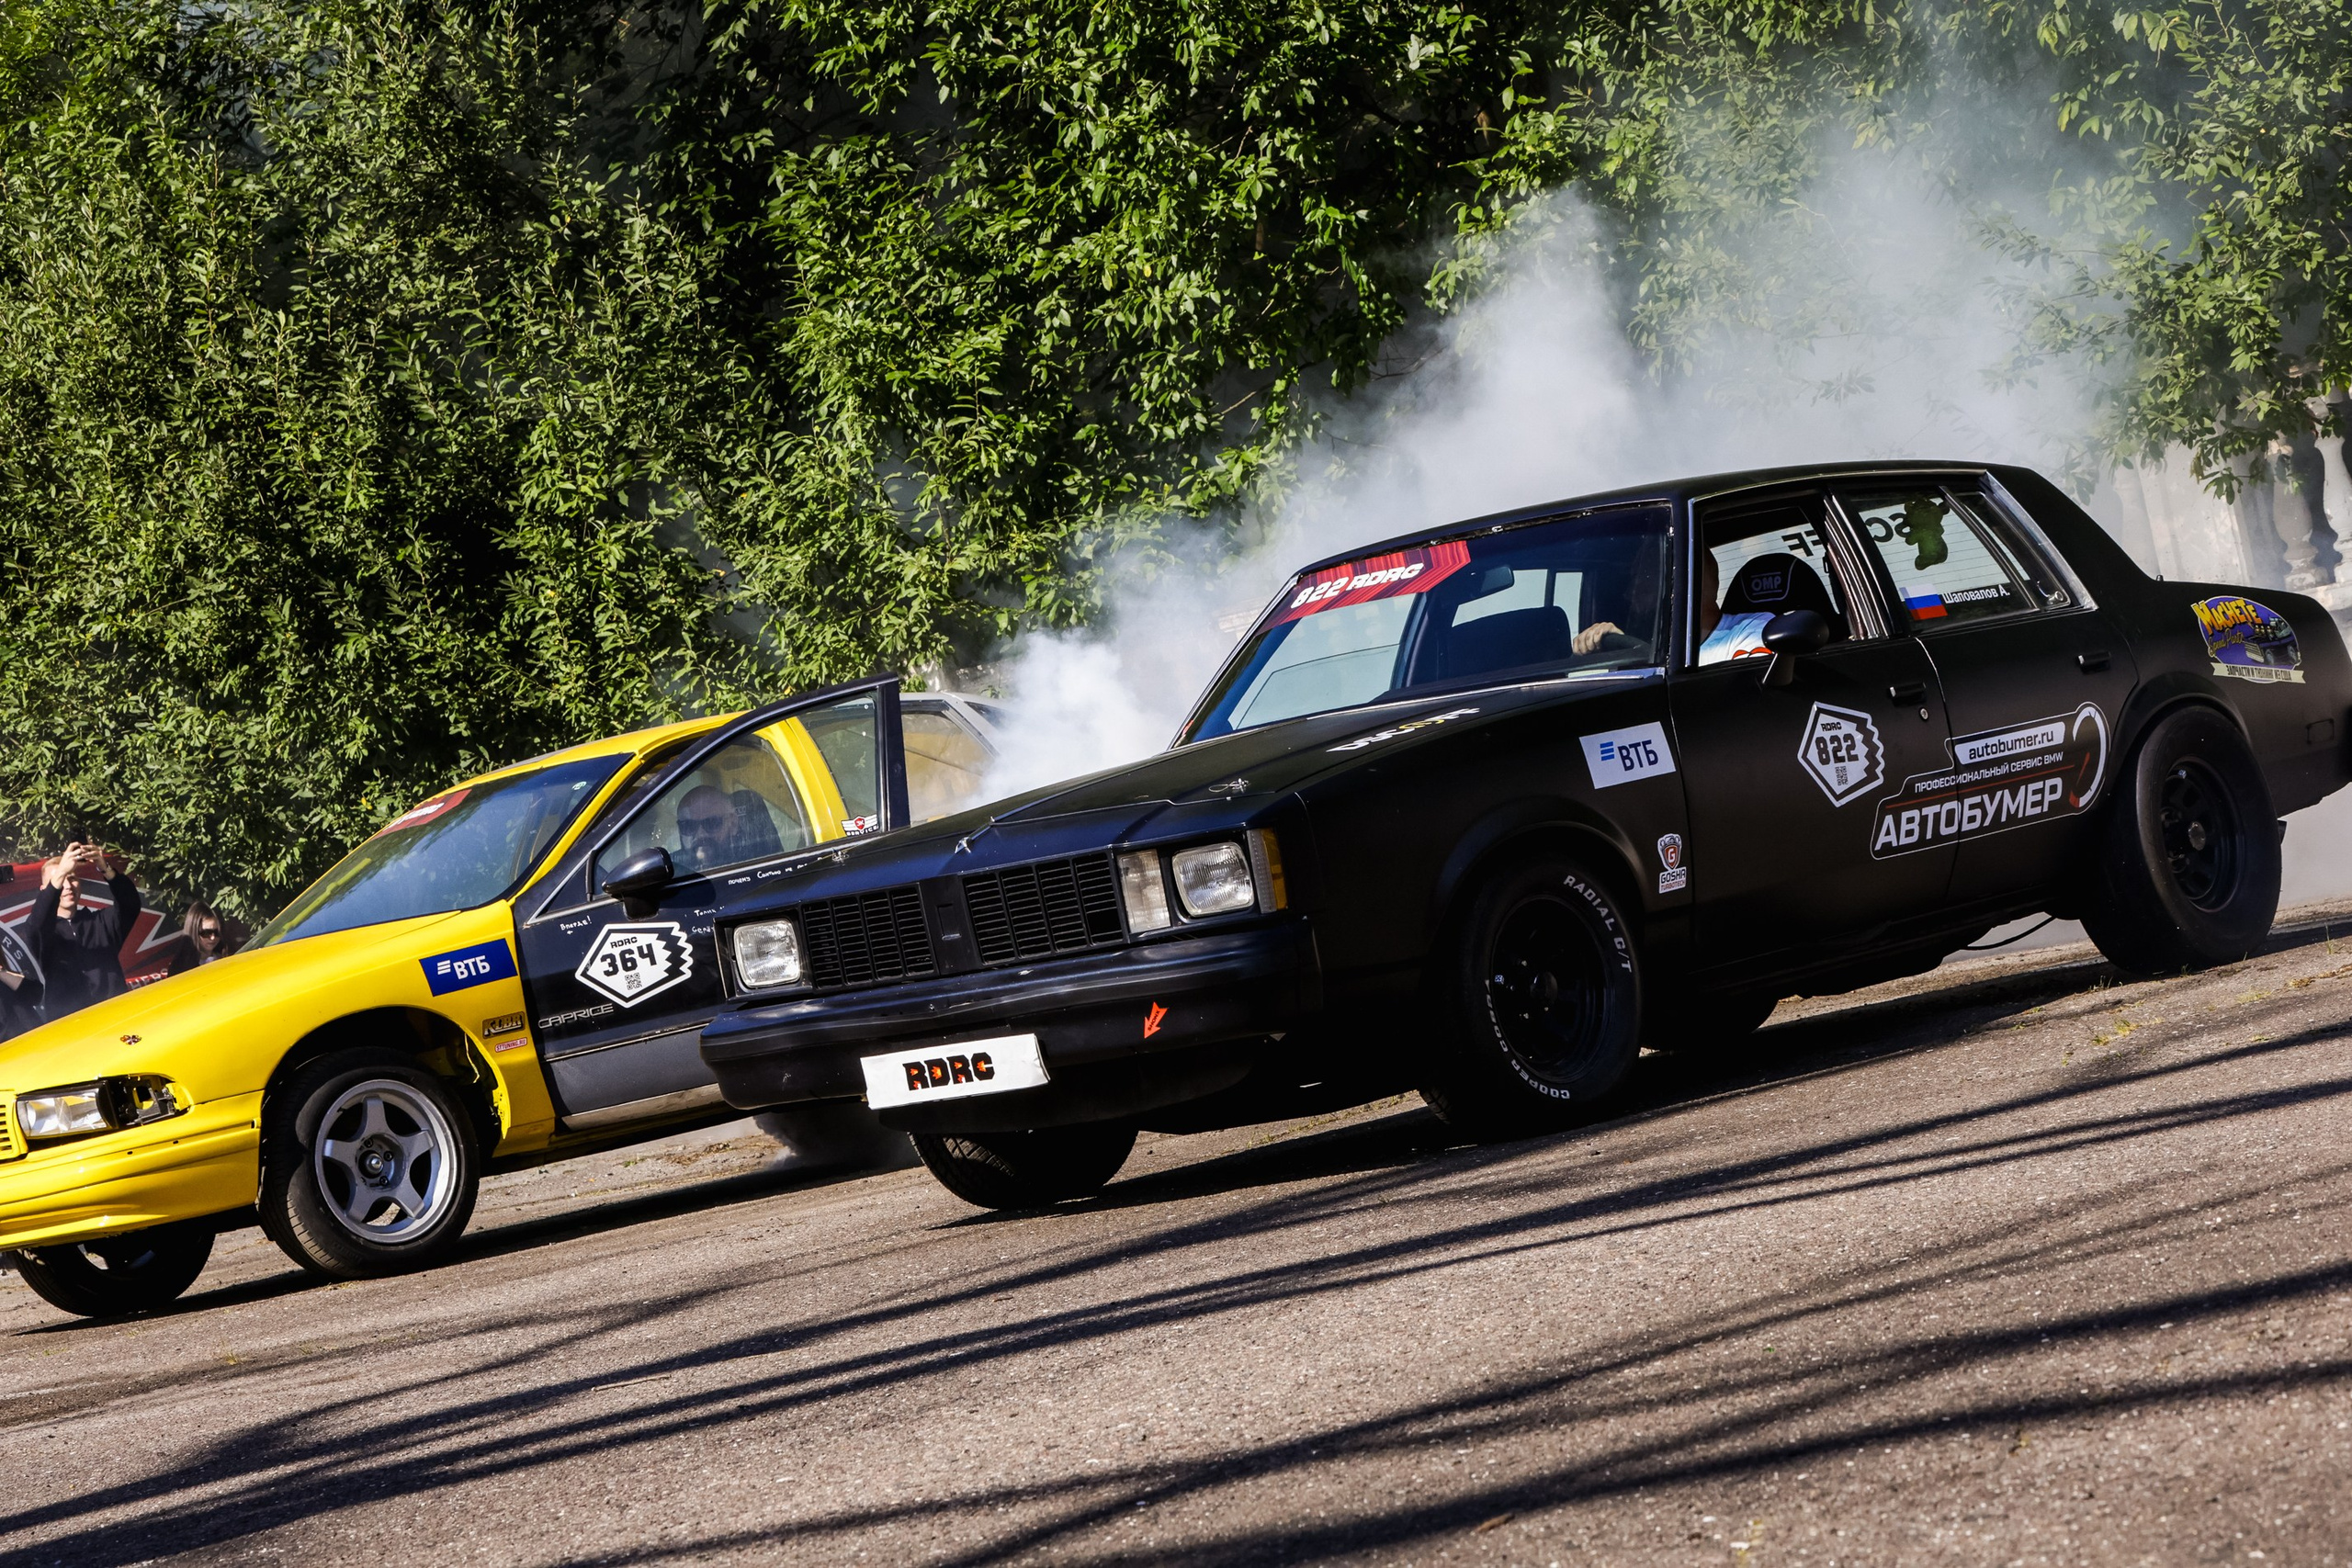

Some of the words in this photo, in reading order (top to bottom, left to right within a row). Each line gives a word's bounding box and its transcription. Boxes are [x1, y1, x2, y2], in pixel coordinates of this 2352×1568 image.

[1291, 577, 1349, 608] 822
[1346, 563, 1424, 591] RDRC
[1751, 576, 1781, 592] OMP
[1941, 588, 1998, 604] Шаповалов
[1997, 584, 2010, 597] А.
[2191, 599, 2263, 636] MACHETE
[1820, 721, 1842, 732] RDRC
[1617, 739, 1658, 772] ВТБ
[1815, 733, 1860, 765] 822
[1968, 730, 2054, 760] autobumer.ru
[1915, 762, 2009, 793] ПРОФЕССИОНАЛЬНЫЙ
[2010, 755, 2043, 773] СЕРВИС
[2043, 751, 2064, 765] BMW
[1874, 777, 2063, 851] АВТОБУМЕР
[1668, 848, 1676, 863] G
[1660, 869, 1686, 884] GOSHA
[1564, 875, 1614, 931] RADIAL
[1613, 937, 1632, 973] G/T
[610, 936, 638, 949] RDRC
[453, 955, 491, 980] ВТБ
[600, 942, 657, 977] 364
[537, 1003, 614, 1029] CAPRICE
[902, 1052, 995, 1091] RDRC
[1511, 1059, 1570, 1100] COOPER
